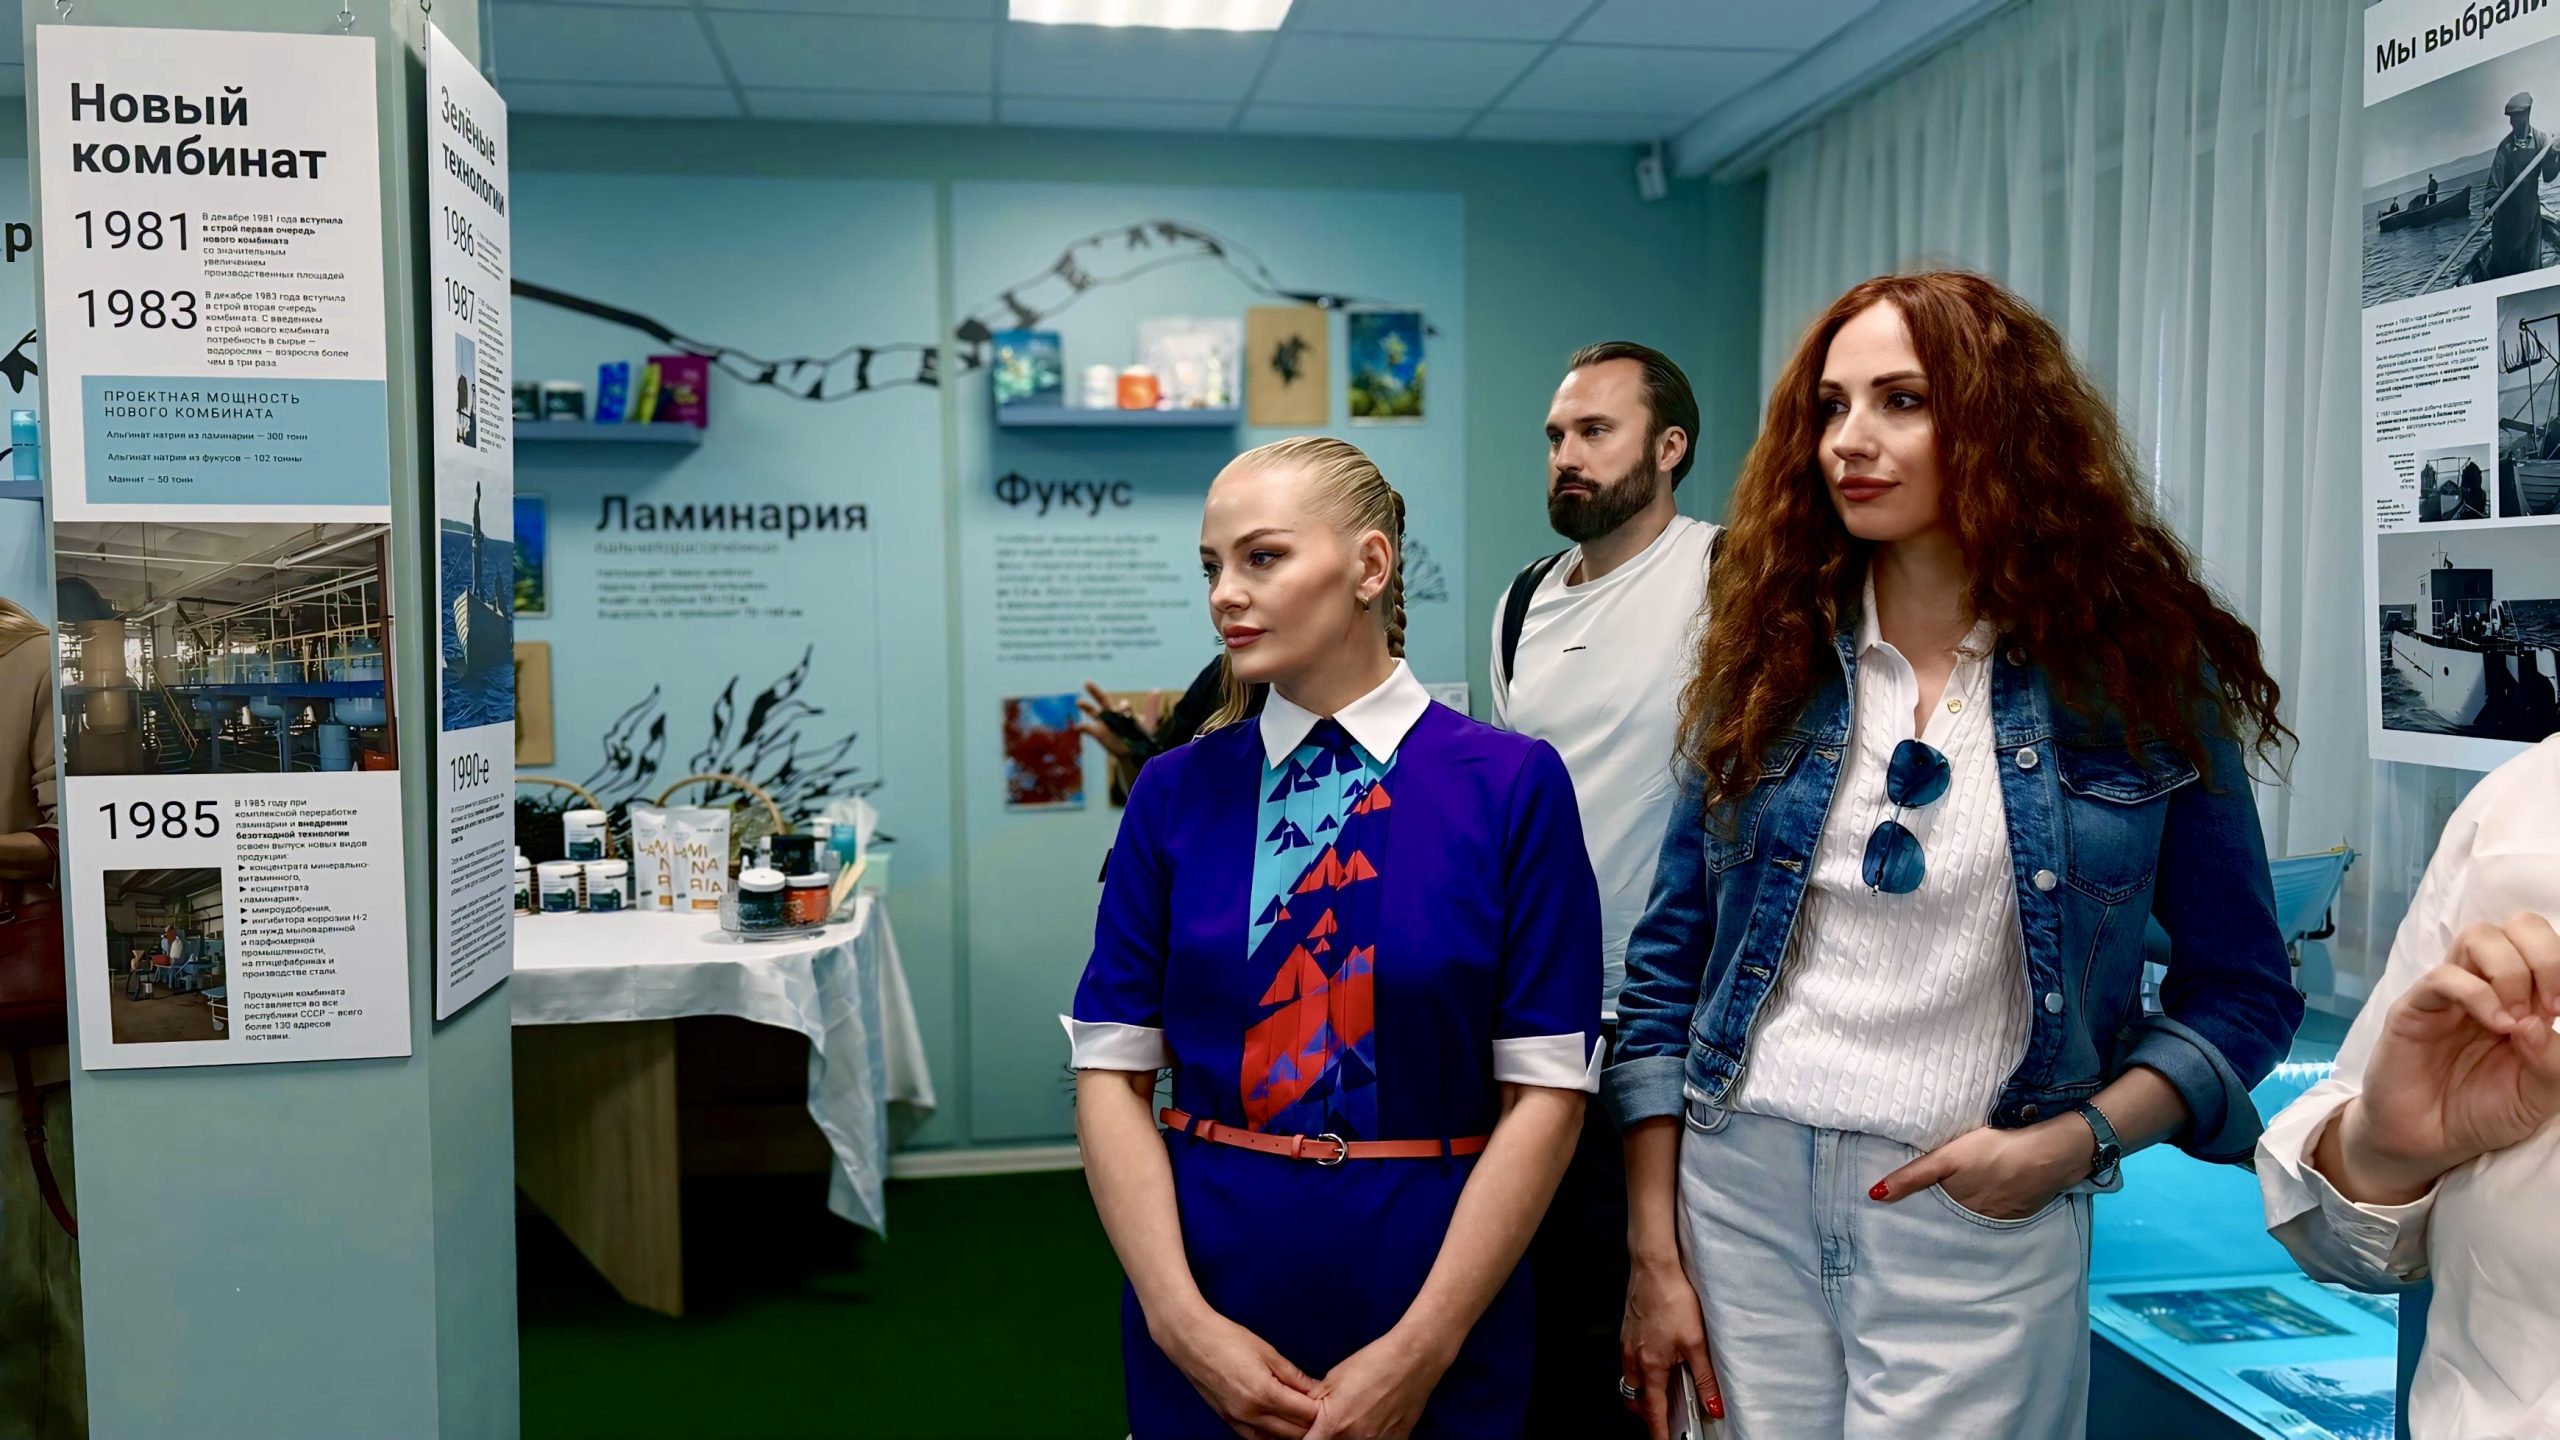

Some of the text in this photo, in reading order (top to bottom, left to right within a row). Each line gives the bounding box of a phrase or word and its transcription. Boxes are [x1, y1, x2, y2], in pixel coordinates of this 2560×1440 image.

[2376, 36, 2416, 74] Мы
[71, 82, 248, 126] Новый
[442, 86, 496, 167] Зелёные
[73, 134, 327, 179] комбинат
[442, 142, 505, 218] технологии
[210, 214, 250, 223] декабре
[253, 214, 273, 222] 1981
[276, 216, 298, 224] года
[300, 217, 343, 226] вступила
[75, 210, 187, 251] 1981
[210, 224, 238, 234] строй
[240, 226, 274, 234] первая
[276, 227, 316, 236] очередь
[444, 206, 475, 258] 1986
[3, 222, 33, 263] р
[238, 236, 289, 245] комбината
[217, 248, 286, 256] значительным
[204, 259, 266, 267] увеличением
[204, 270, 345, 280] производственных площадей
[205, 290, 346, 303] В декабре 1983 года вступила
[445, 276, 475, 325] 1987
[78, 289, 198, 330] 1983
[213, 302, 241, 312] строй
[243, 304, 276, 312] вторая
[278, 305, 317, 314] очередь
[262, 314, 268, 322] С
[270, 316, 323, 324] введением
[214, 325, 242, 334] строй
[279, 326, 330, 335] комбината
[206, 336, 267, 345] потребность
[276, 338, 306, 346] сырье
[207, 348, 263, 356] водорослях
[275, 349, 320, 357] возросла
[321, 349, 349, 357] более
[236, 359, 253, 368] три
[104, 391, 300, 405] ПРОЕКТНАЯ МОЩНОСТЬ
[105, 406, 274, 419] НОВОГО КОМБИНАТА
[106, 431, 151, 439] Альгинат
[153, 432, 186, 440] натрия
[201, 433, 255, 441] ламинарии
[267, 432, 284, 441] 300
[108, 453, 151, 461] Альгинат
[153, 454, 187, 463] натрия
[202, 454, 241, 463] фукусов
[254, 454, 271, 462] 102
[108, 475, 145, 483] Маннит
[158, 475, 169, 484] 50
[995, 470, 1133, 517] Фукус
[596, 495, 868, 540] Ламинария
[450, 752, 490, 793] 1990-е
[234, 800, 241, 808] В
[244, 799, 266, 807] 1985
[267, 800, 288, 808] году
[235, 808, 358, 818] комплексной переработке
[99, 800, 220, 840] 1985
[298, 820, 348, 828] внедрении
[236, 830, 296, 840] безотходной
[272, 843, 306, 851] выпуск
[250, 864, 308, 872] концентрата
[691, 857, 720, 875] NA
[250, 885, 309, 893] концентрата
[690, 878, 724, 893] RIA
[252, 916, 305, 925] ингибитора
[307, 916, 351, 924] коррозии
[240, 924, 356, 937] для нужд мыловаренной
[249, 936, 315, 947] парфюмерной
[255, 958, 326, 967] птицефабриках
[242, 970, 307, 979] производстве
[243, 989, 346, 1000] Продукция комбината
[244, 1001, 307, 1010] поставляется
[244, 1012, 298, 1022] республики
[300, 1009, 326, 1018] СССР
[337, 1009, 363, 1017] всего
[245, 1021, 331, 1031] более 130 адресов
